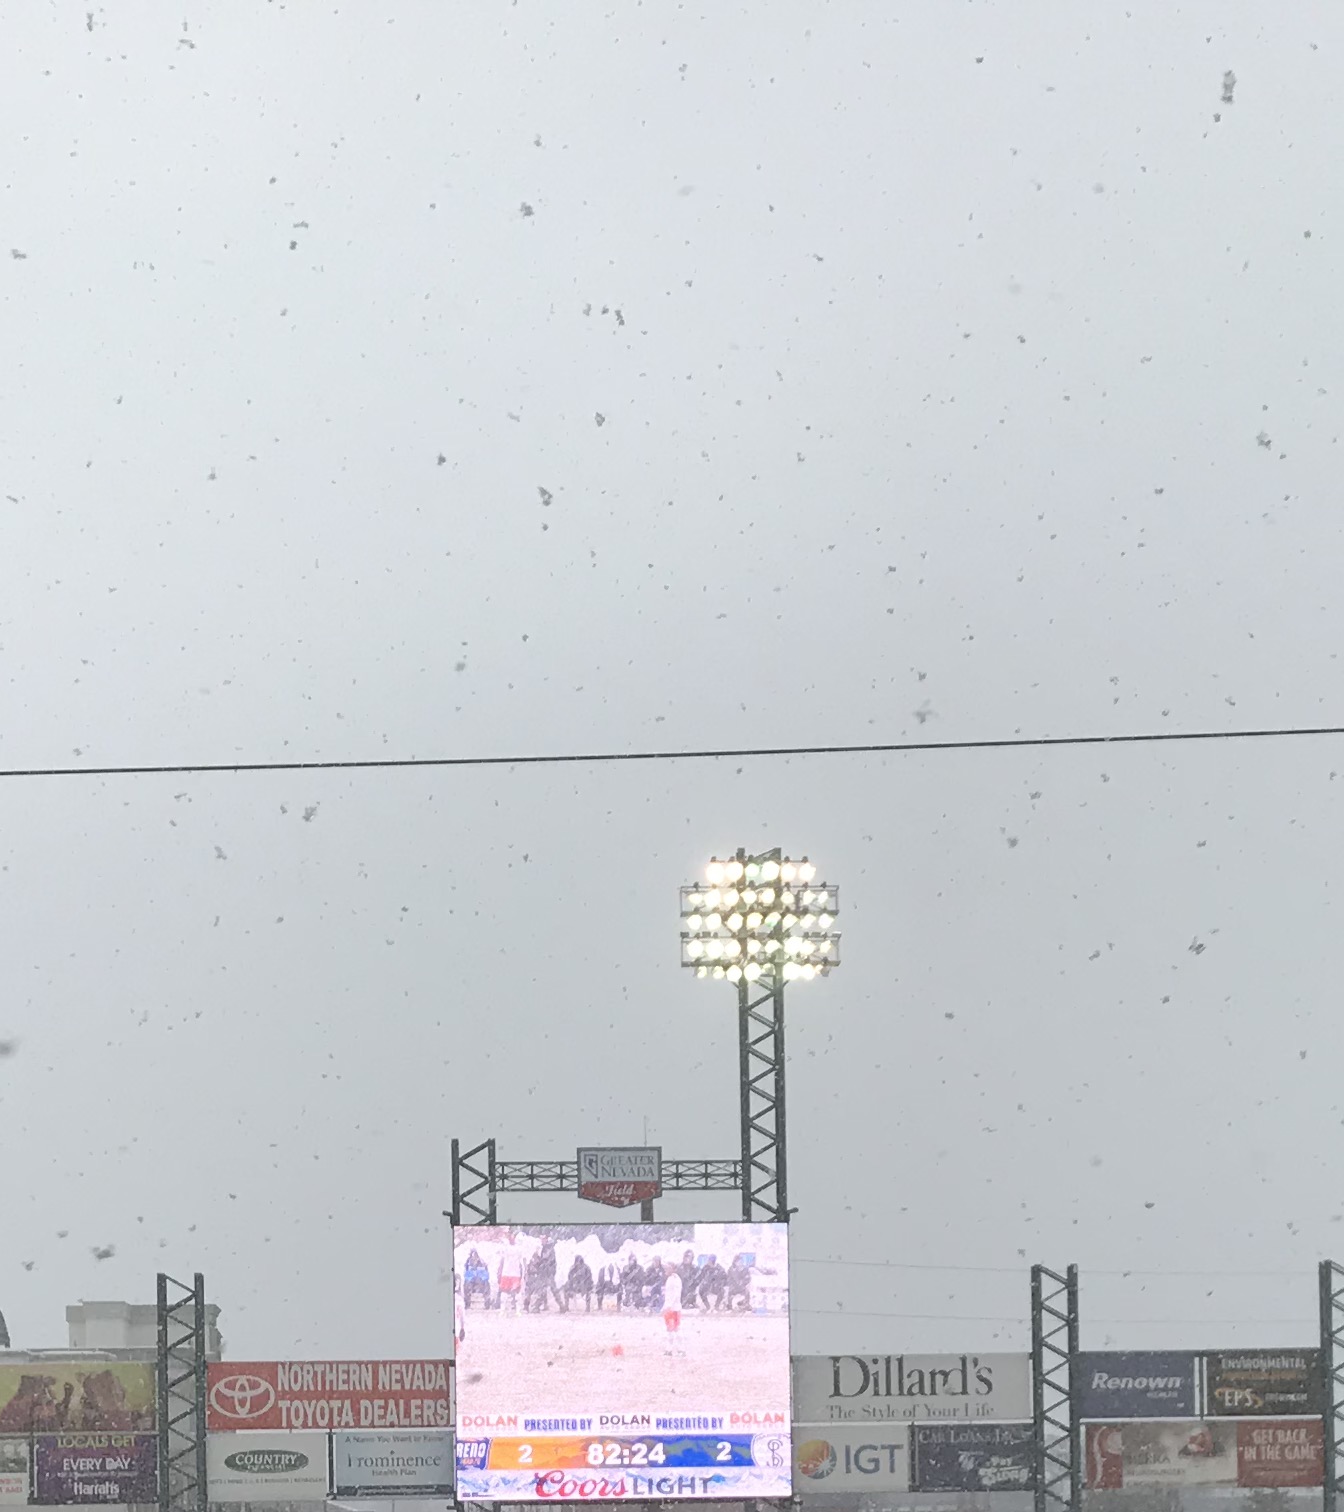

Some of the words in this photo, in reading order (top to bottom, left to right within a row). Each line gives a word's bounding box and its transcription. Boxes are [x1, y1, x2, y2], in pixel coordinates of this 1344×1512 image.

[600, 1155, 655, 1166] GREATER
[600, 1166, 655, 1178] NEVADA
[605, 1183, 635, 1197] Field
[1221, 1357, 1307, 1369] ENVIRONMENTAL
[277, 1363, 374, 1391] NORTHERN
[378, 1363, 448, 1391] NEVADA
[828, 1354, 994, 1398] Dillard's
[1092, 1371, 1182, 1390] Renown
[1224, 1388, 1254, 1407] EPS
[278, 1399, 355, 1428] TOYOTA
[359, 1398, 449, 1427] DEALERS
[729, 1411, 785, 1425] DOLAN
[826, 1404, 855, 1419] The
[861, 1403, 898, 1422] Style
[902, 1404, 921, 1418] of
[923, 1403, 958, 1417] Your
[964, 1402, 995, 1416] Life
[462, 1415, 518, 1427] DOLAN
[523, 1417, 578, 1432] PRESENTED
[580, 1417, 593, 1431] BY
[599, 1414, 651, 1426] DOLAN
[656, 1415, 709, 1430] PRESENTED
[711, 1417, 724, 1429] BY
[58, 1435, 109, 1449] LOCALS
[111, 1435, 136, 1448] GET
[1251, 1428, 1274, 1443] GET
[1277, 1428, 1308, 1442] BACK
[456, 1442, 487, 1458] RENO
[517, 1444, 533, 1463] 2
[587, 1442, 666, 1465] 82:24
[716, 1441, 732, 1461] 2
[1244, 1445, 1257, 1460] IN
[1260, 1443, 1282, 1460] THE
[1284, 1442, 1316, 1460] GAME
[63, 1457, 103, 1471] EVERY
[105, 1456, 132, 1470] DAY
[235, 1453, 297, 1465] COUNTRY
[844, 1443, 905, 1475] IGT
[400, 1467, 417, 1476] Plan
[534, 1470, 629, 1498] Coors
[632, 1474, 712, 1495] LIGHT
